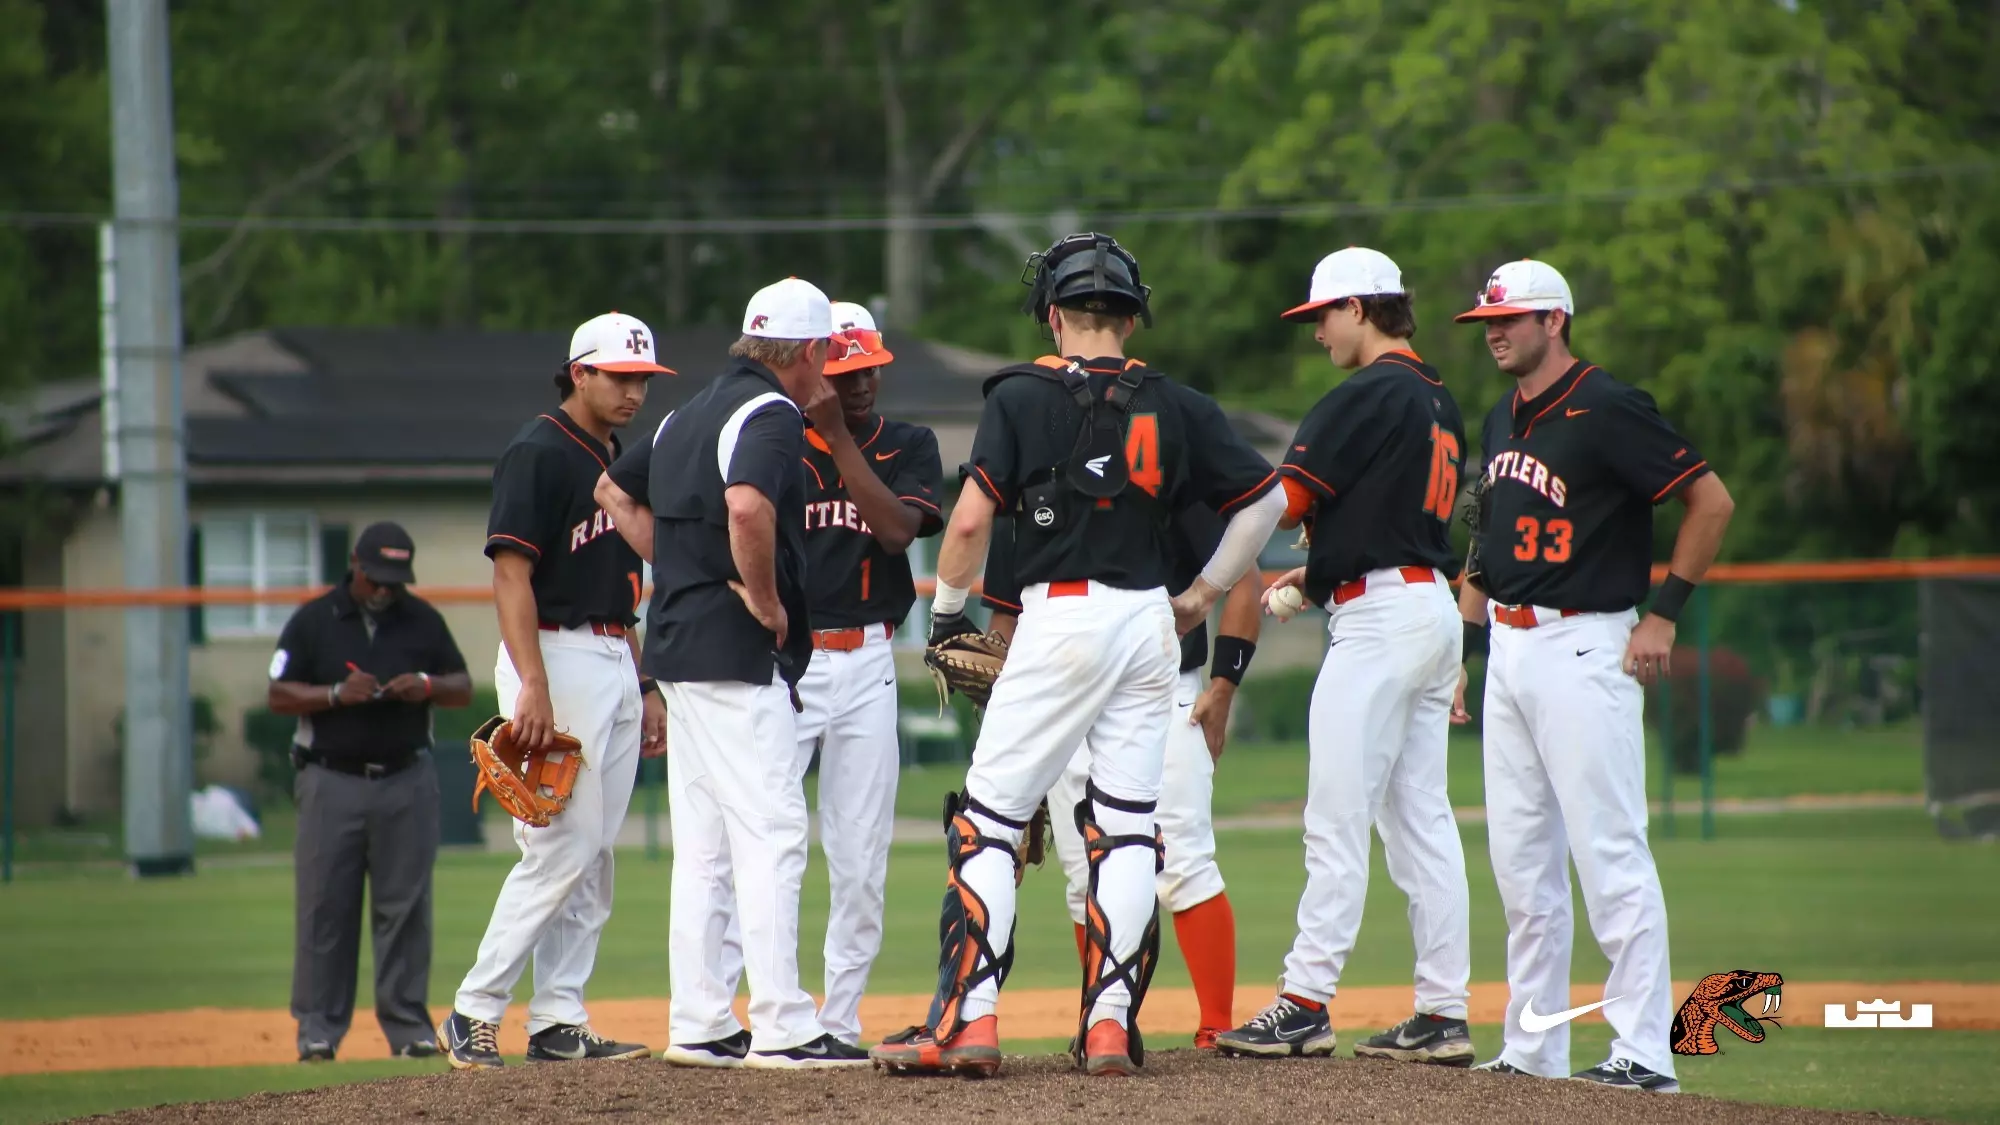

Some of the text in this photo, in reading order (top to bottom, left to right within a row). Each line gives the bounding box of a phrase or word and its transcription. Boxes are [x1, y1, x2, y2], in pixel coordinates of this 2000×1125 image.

[1422, 421, 1460, 522] 16
[1513, 515, 1573, 563] 33
[861, 556, 872, 602] 1
